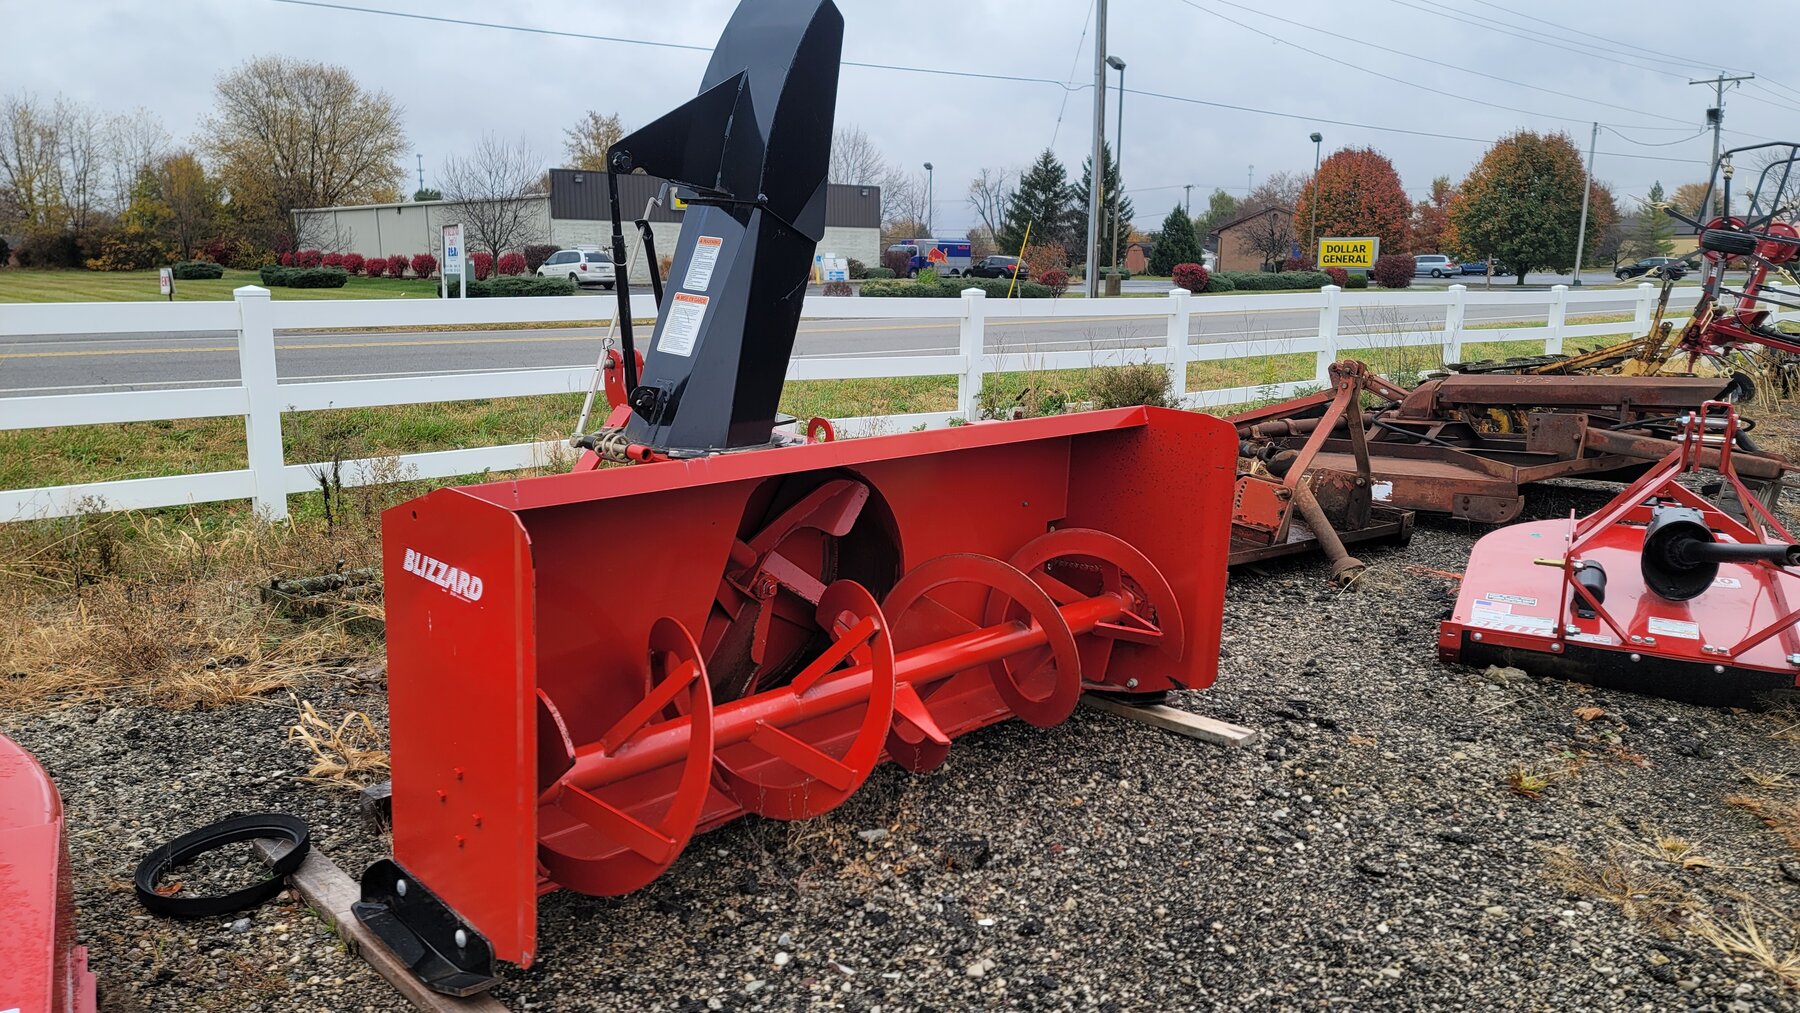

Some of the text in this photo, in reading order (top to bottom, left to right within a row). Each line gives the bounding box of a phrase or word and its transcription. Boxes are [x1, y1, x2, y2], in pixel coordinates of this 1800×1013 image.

[1326, 244, 1366, 253] DOLLAR
[1322, 255, 1368, 263] GENERAL
[402, 547, 483, 601] BLIZZARD
